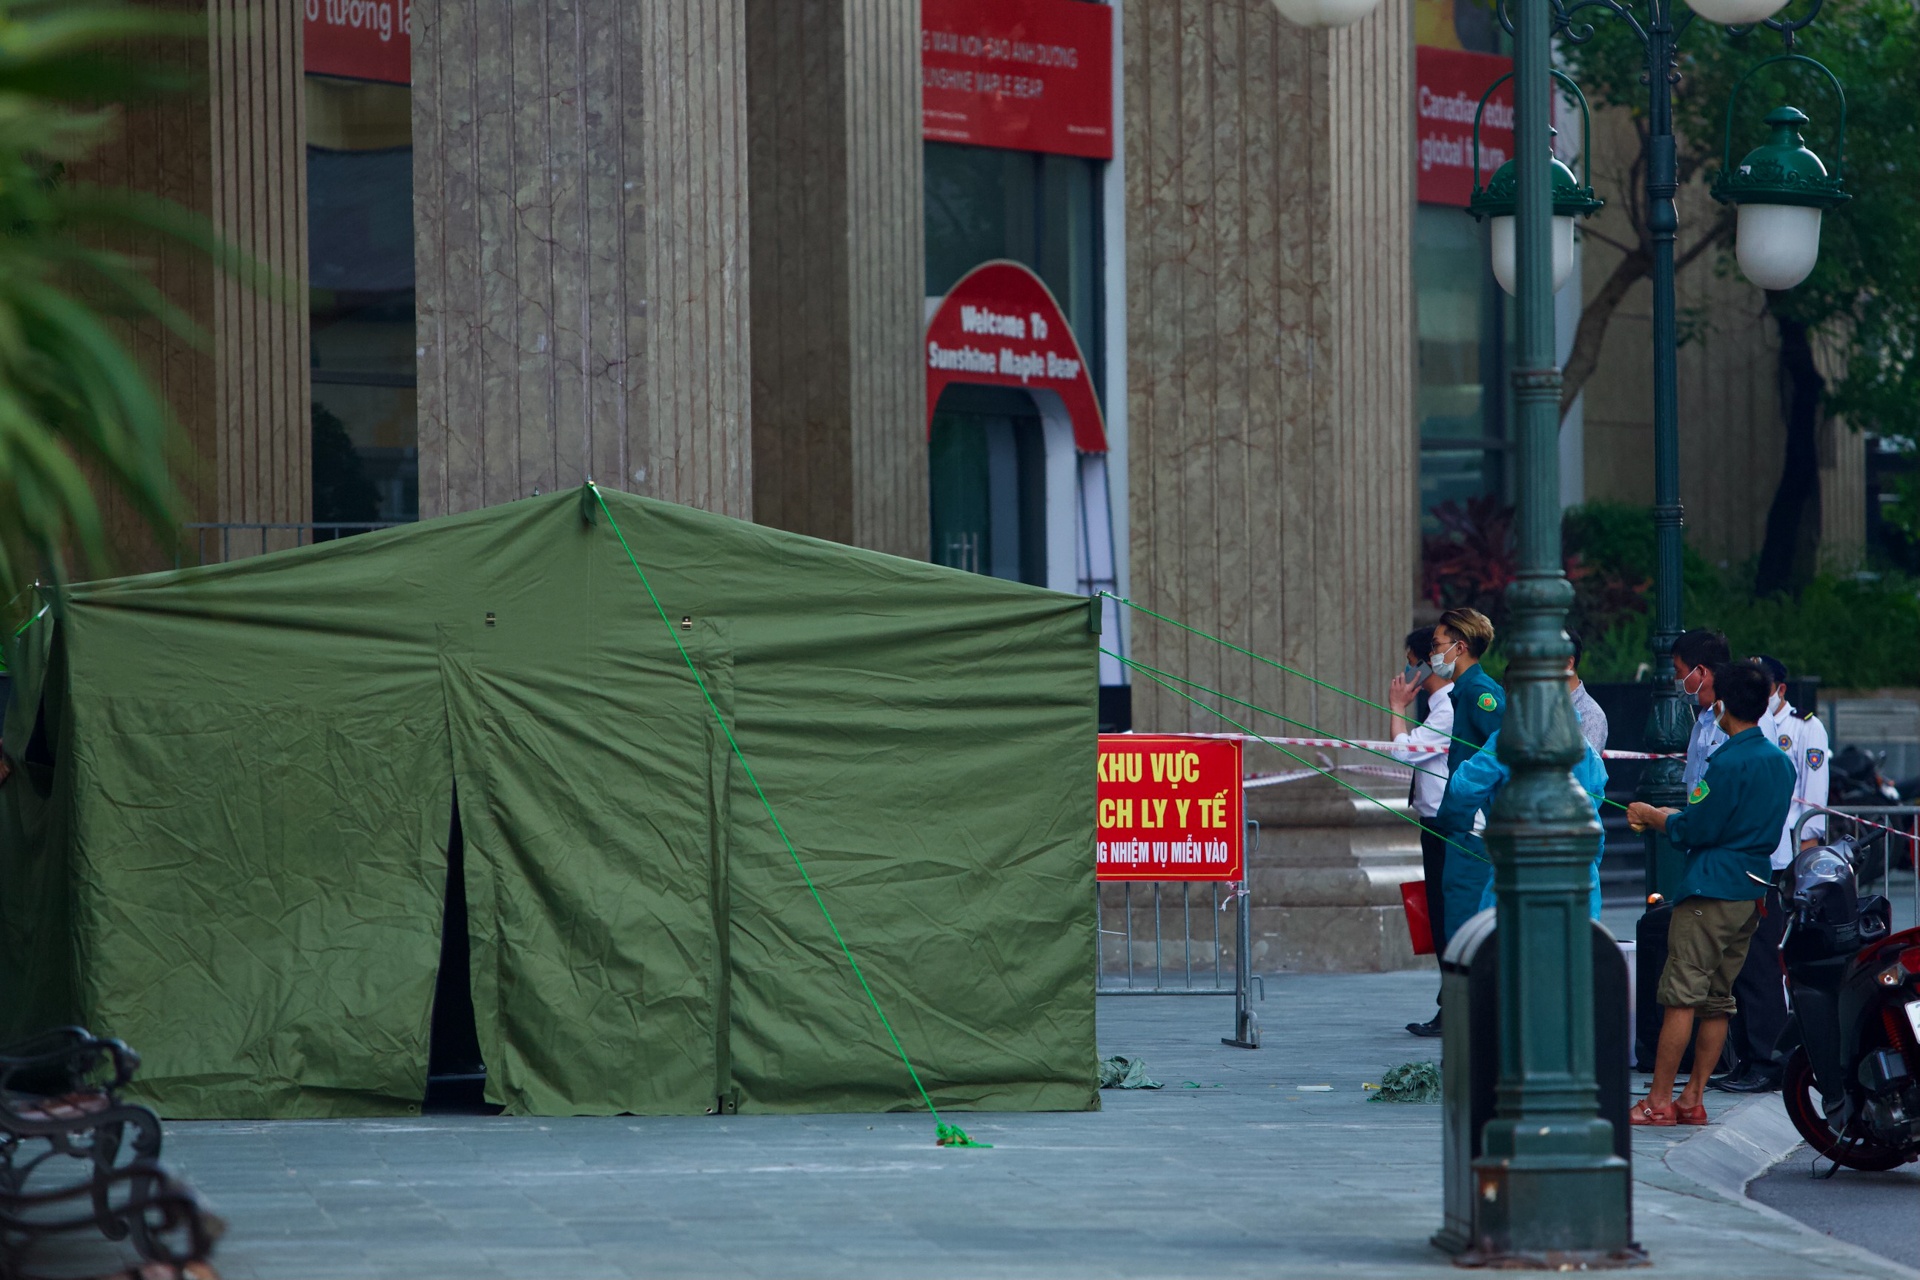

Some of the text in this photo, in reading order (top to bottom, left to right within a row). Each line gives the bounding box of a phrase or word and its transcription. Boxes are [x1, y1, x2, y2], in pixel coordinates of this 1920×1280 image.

[1419, 85, 1482, 125] Canadian
[1422, 131, 1463, 171] global
[961, 305, 1048, 340] Welcome To
[929, 341, 1080, 384] Sunshine Maple Bear
[1098, 750, 1200, 790] KHU VỰC
[1097, 789, 1229, 829] CH LY Y TẾ
[1111, 837, 1149, 868] NHIỆM
[1152, 842, 1168, 868] VỤ
[1171, 834, 1201, 863] MIỄN
[1204, 837, 1228, 863] VÀO
